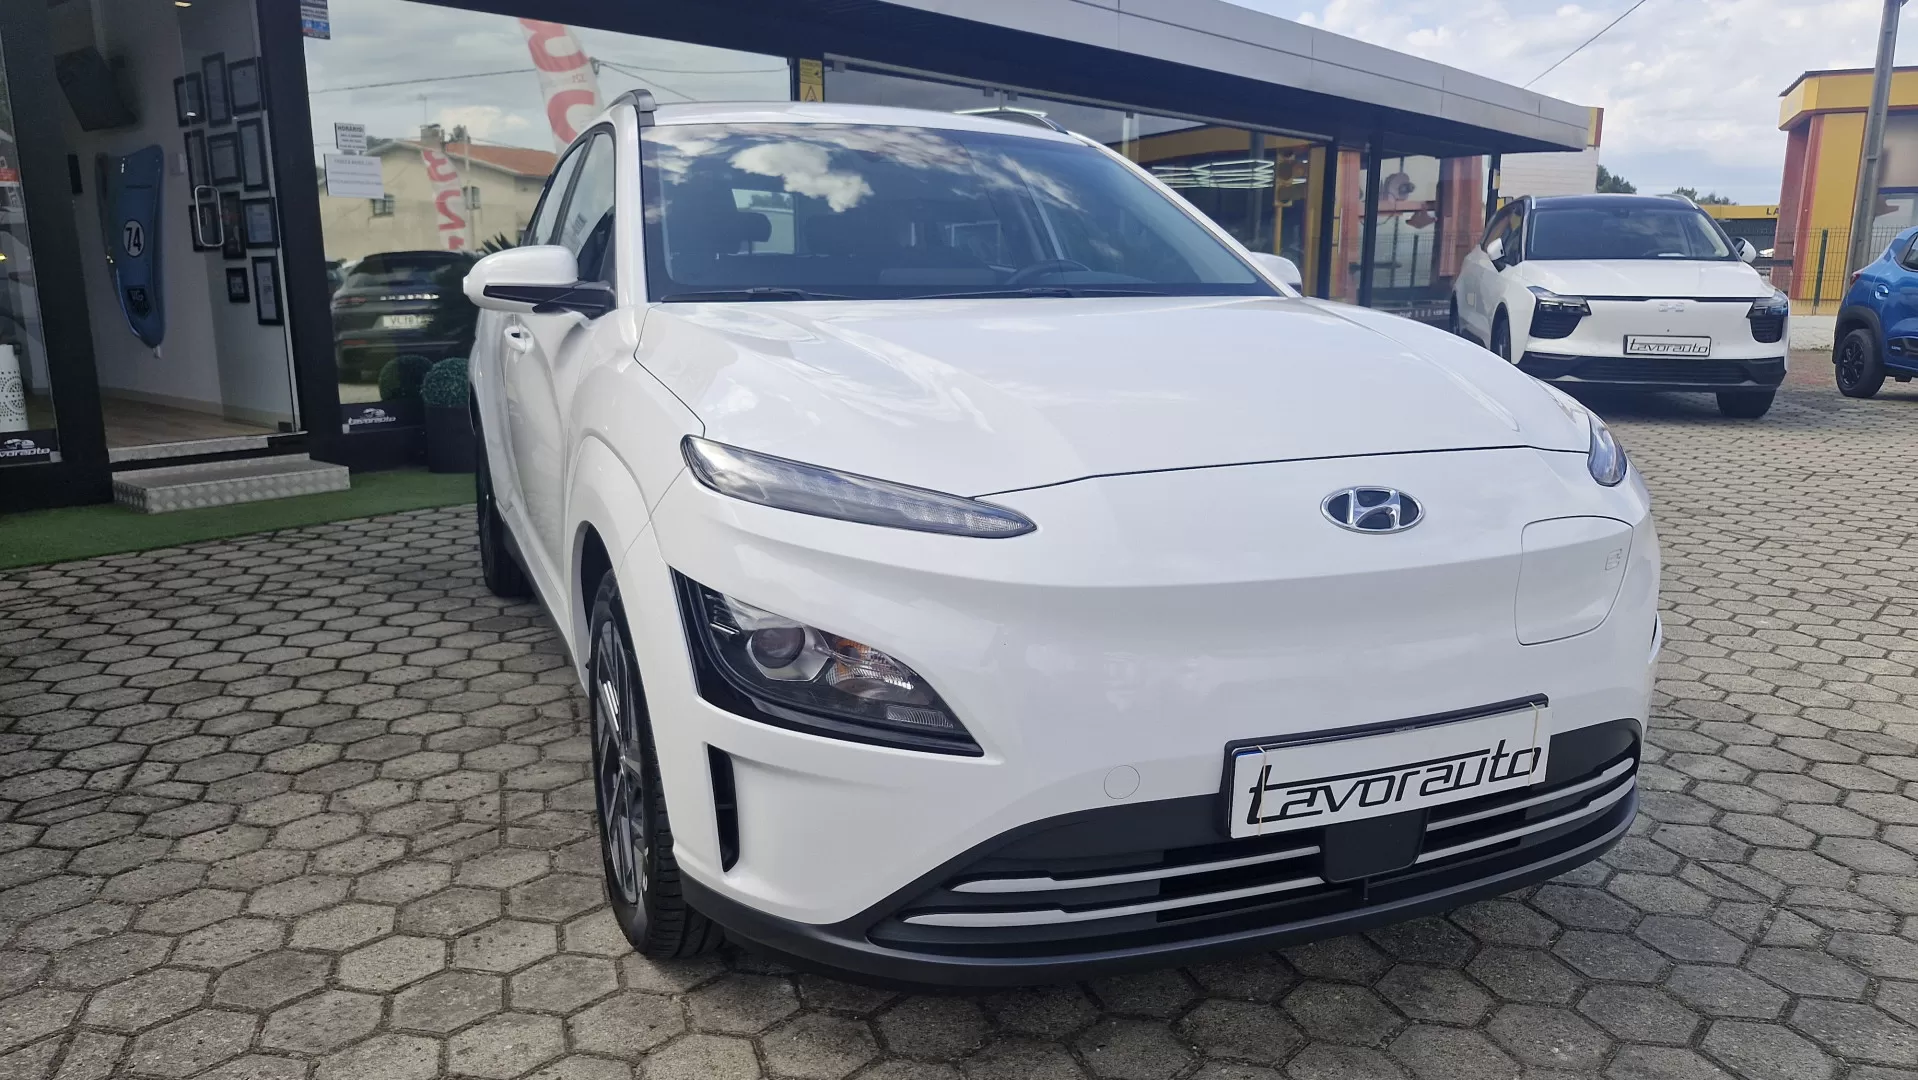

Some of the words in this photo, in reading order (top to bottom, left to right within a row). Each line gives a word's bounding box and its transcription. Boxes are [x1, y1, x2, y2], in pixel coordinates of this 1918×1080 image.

[126, 227, 142, 251] 74
[1629, 338, 1708, 353] tavorauto
[0, 447, 50, 457] vorauto
[1246, 739, 1541, 824] tavorauto
